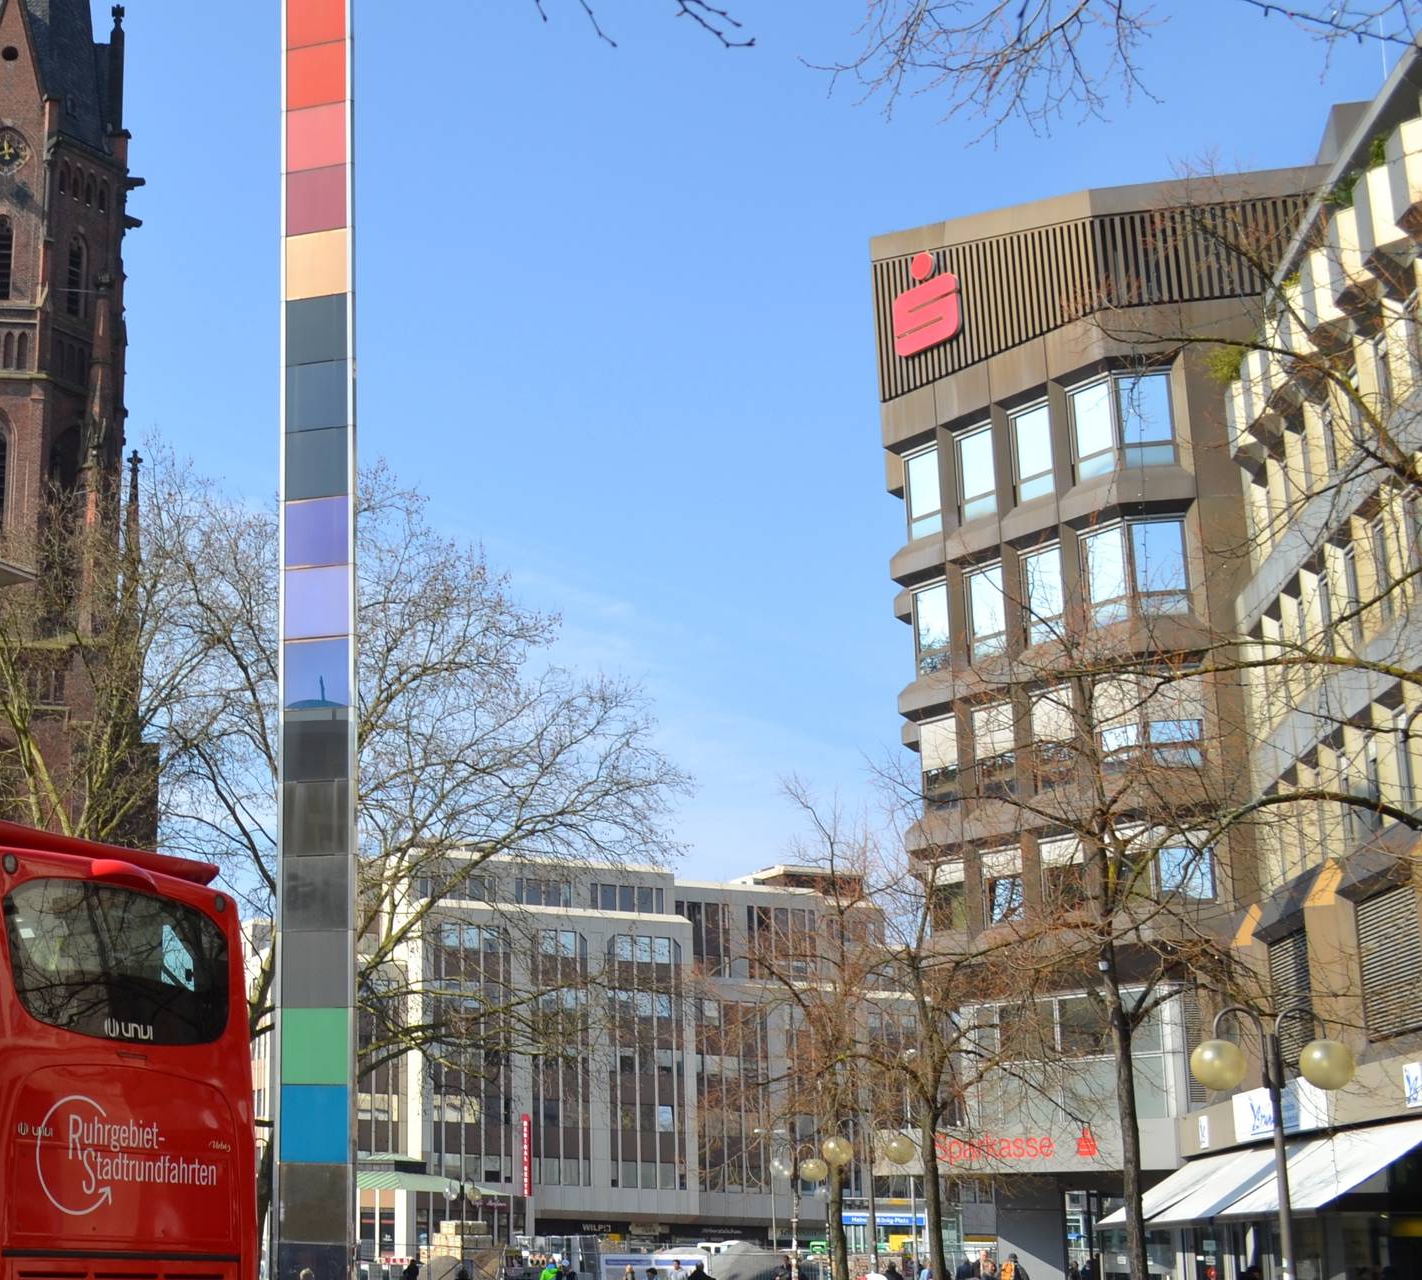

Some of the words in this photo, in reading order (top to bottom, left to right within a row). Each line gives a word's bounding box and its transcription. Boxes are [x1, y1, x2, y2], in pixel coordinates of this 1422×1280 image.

[68, 1114, 166, 1160] Ruhrgebiet-
[935, 1130, 1055, 1167] Sparkasse
[82, 1148, 217, 1194] Stadtrundfahrten
